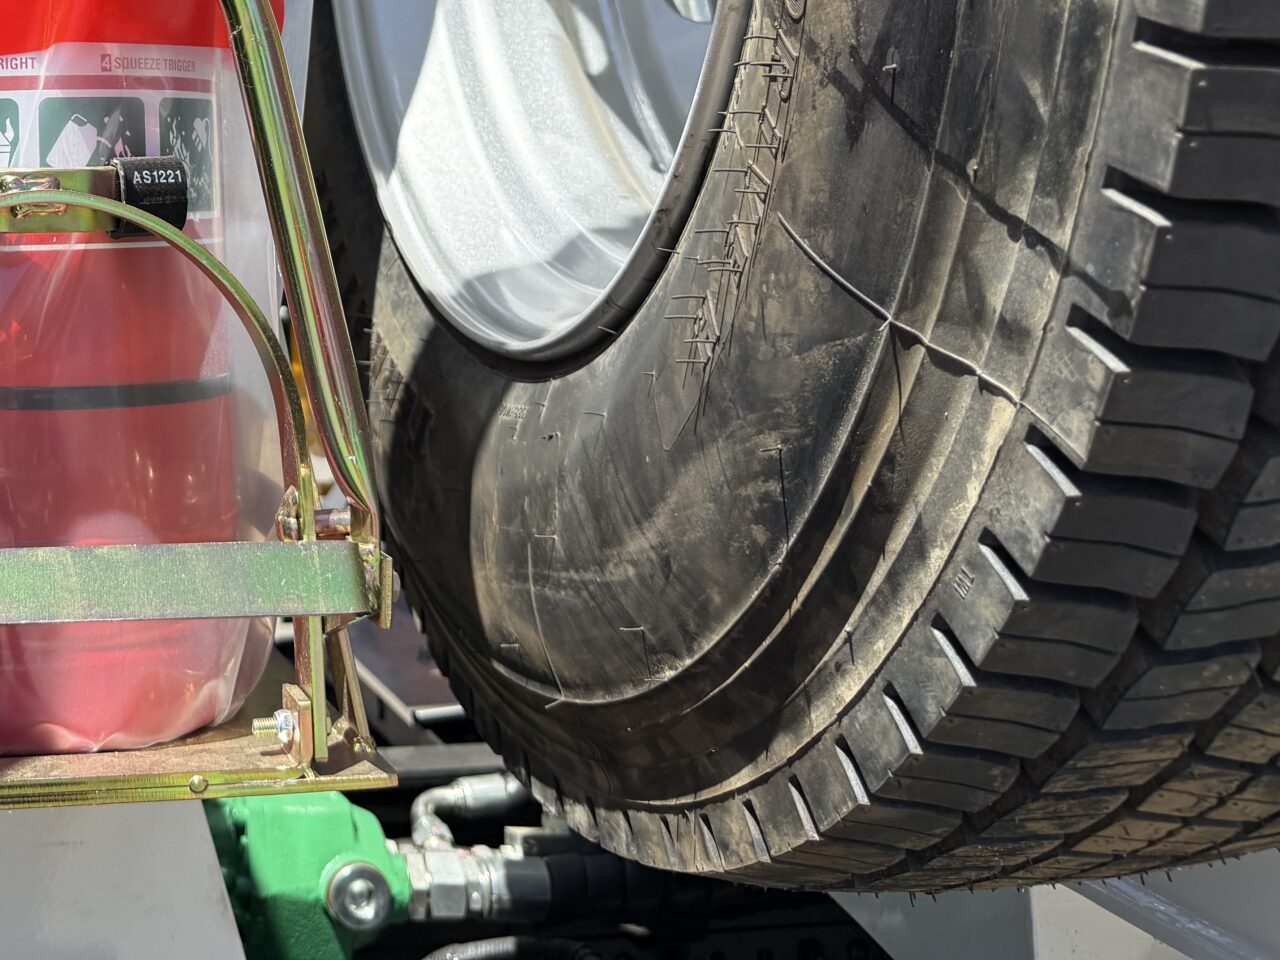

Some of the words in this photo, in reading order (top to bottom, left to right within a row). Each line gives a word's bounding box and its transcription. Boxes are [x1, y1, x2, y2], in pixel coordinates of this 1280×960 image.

[101, 54, 111, 71] 4
[114, 56, 162, 71] SQUEEZE
[163, 58, 196, 73] TRIGGER
[132, 169, 182, 185] AS1221
